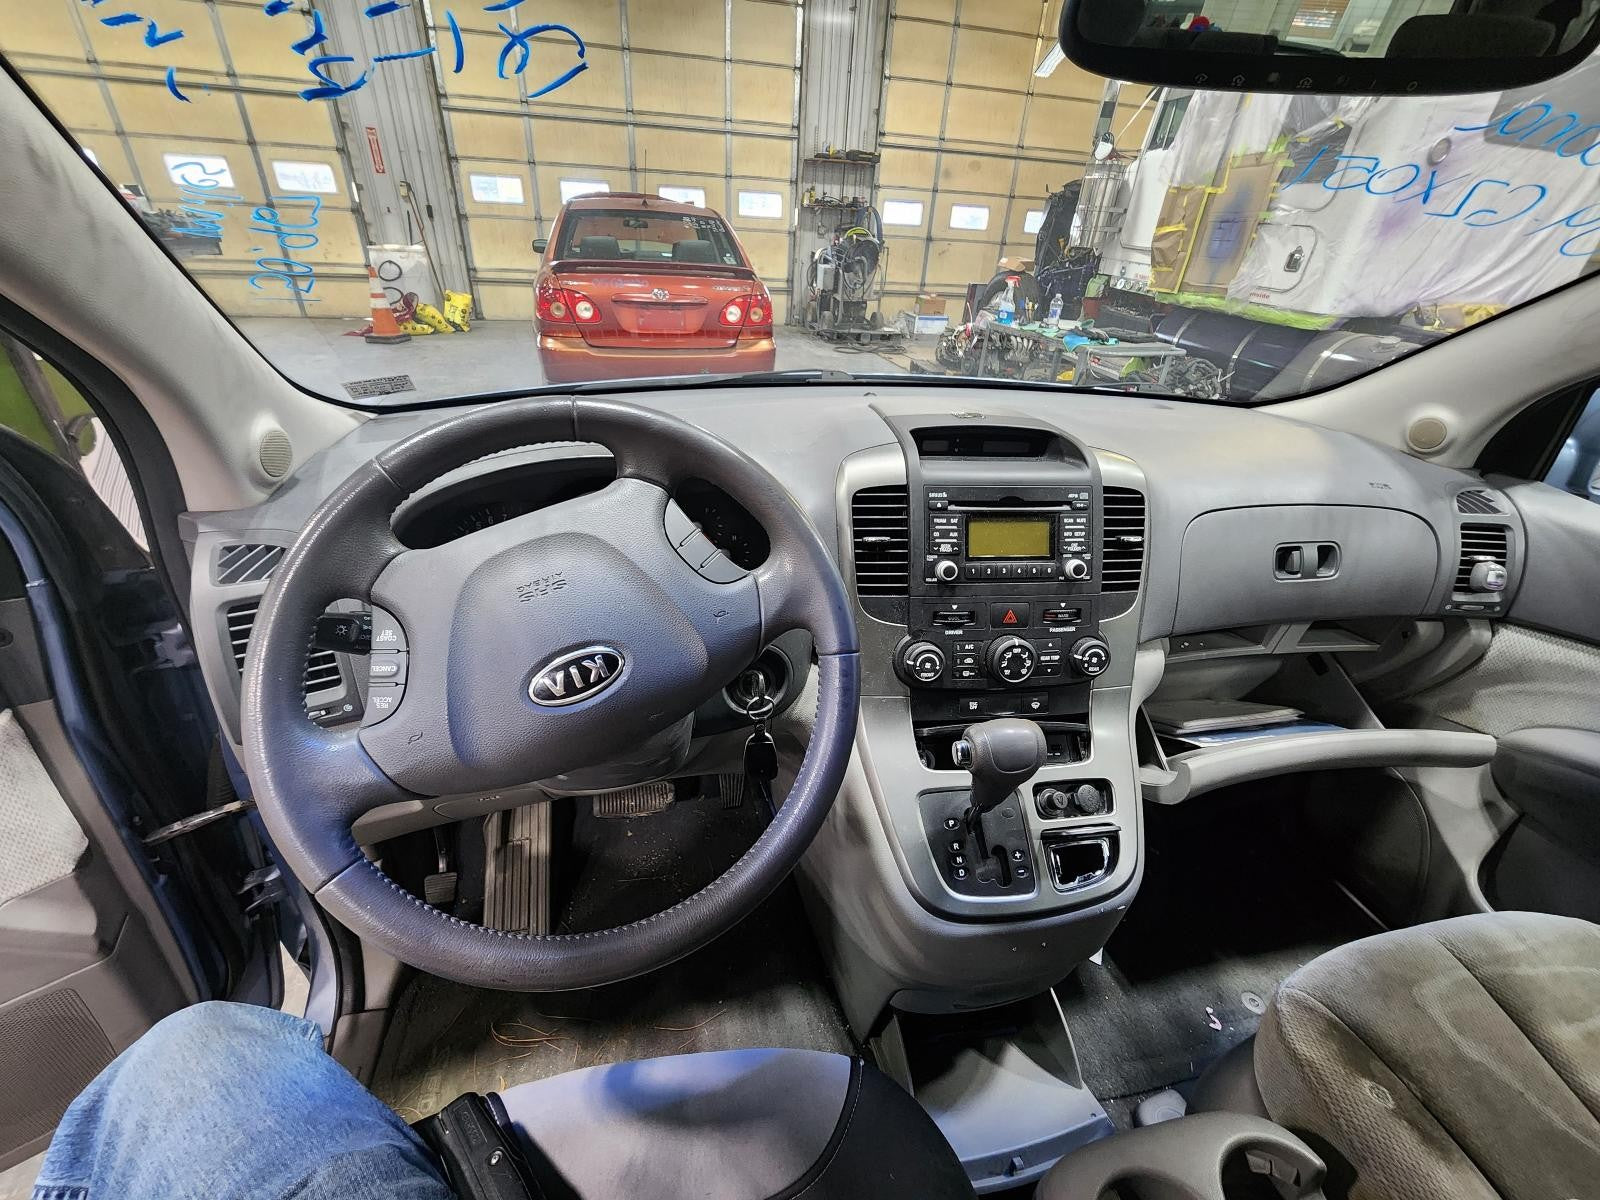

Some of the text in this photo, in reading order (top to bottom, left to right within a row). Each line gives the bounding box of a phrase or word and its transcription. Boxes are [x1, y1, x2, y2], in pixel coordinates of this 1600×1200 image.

[540, 654, 611, 698] KIA
[948, 819, 955, 827] P
[959, 869, 965, 877] D
